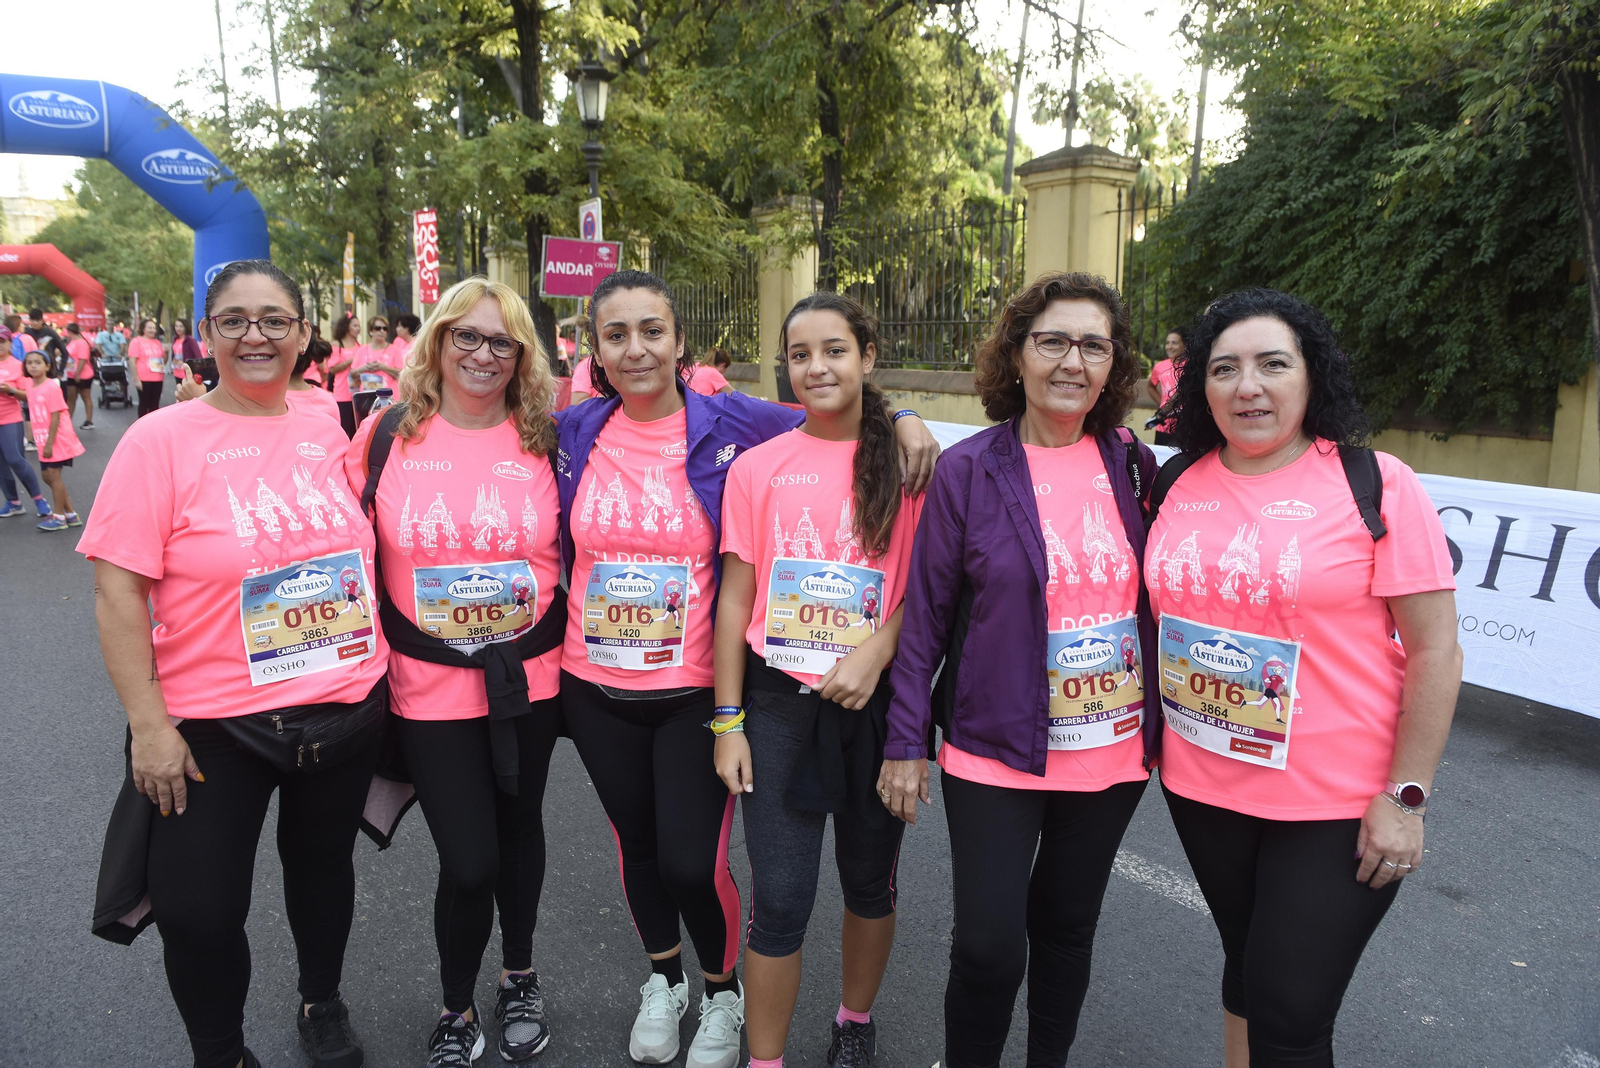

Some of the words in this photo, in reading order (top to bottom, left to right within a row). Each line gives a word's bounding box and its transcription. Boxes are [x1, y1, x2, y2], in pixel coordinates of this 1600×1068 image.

[15, 99, 93, 122] ASTURIANA
[546, 261, 593, 276] ANDAR
[207, 446, 260, 464] OYSHO
[403, 459, 452, 472] OYSHO
[496, 466, 531, 478] ASTURIANA
[770, 474, 819, 488] OYSHO
[1132, 463, 1141, 498] Quechua
[1174, 501, 1220, 513] OYSHO
[1265, 506, 1312, 517] ASTURIANA
[250, 587, 269, 597] SUMA
[279, 579, 330, 596] ASTURIANA
[452, 584, 500, 594] ASTURIANA
[608, 582, 652, 592] ASTURIANA
[803, 580, 851, 595] ASTURIANA
[283, 600, 337, 629] 016
[453, 603, 502, 625] 016
[608, 604, 652, 624] 016
[799, 604, 849, 628] 016
[301, 626, 329, 640] 3863
[467, 625, 493, 636] 3866
[494, 630, 515, 640] MUJER
[618, 628, 640, 638] 1420
[809, 629, 834, 641] 1421
[276, 644, 309, 657] CARRERA
[311, 641, 320, 649] DE
[321, 638, 330, 646] LA
[331, 632, 353, 644] MUJER
[600, 638, 622, 646] CARRERA
[785, 639, 812, 648] CARRERA
[814, 642, 822, 650] DE
[824, 643, 833, 651] LA
[1166, 632, 1185, 644] SUMA
[591, 650, 618, 661] OYSHO
[771, 653, 805, 664] OYSHO
[1060, 648, 1112, 664] ASTURIANA
[1192, 646, 1249, 670] ASTURIANA
[263, 659, 306, 675] OYSHO
[1062, 672, 1115, 699] 016
[1190, 672, 1245, 705] 016
[1083, 700, 1104, 713] 586
[1200, 701, 1229, 719] 3864
[1053, 717, 1087, 726] CARRERA
[1109, 706, 1128, 718] MUJER
[1177, 705, 1205, 722] CARRERA
[1207, 716, 1216, 726] DE
[1218, 719, 1227, 729] LA
[1228, 722, 1255, 736] MUJER
[1121, 720, 1137, 730] Santander
[1168, 714, 1198, 737] OYSHO
[1048, 733, 1082, 743] YSHO
[1242, 744, 1268, 754] Santander
